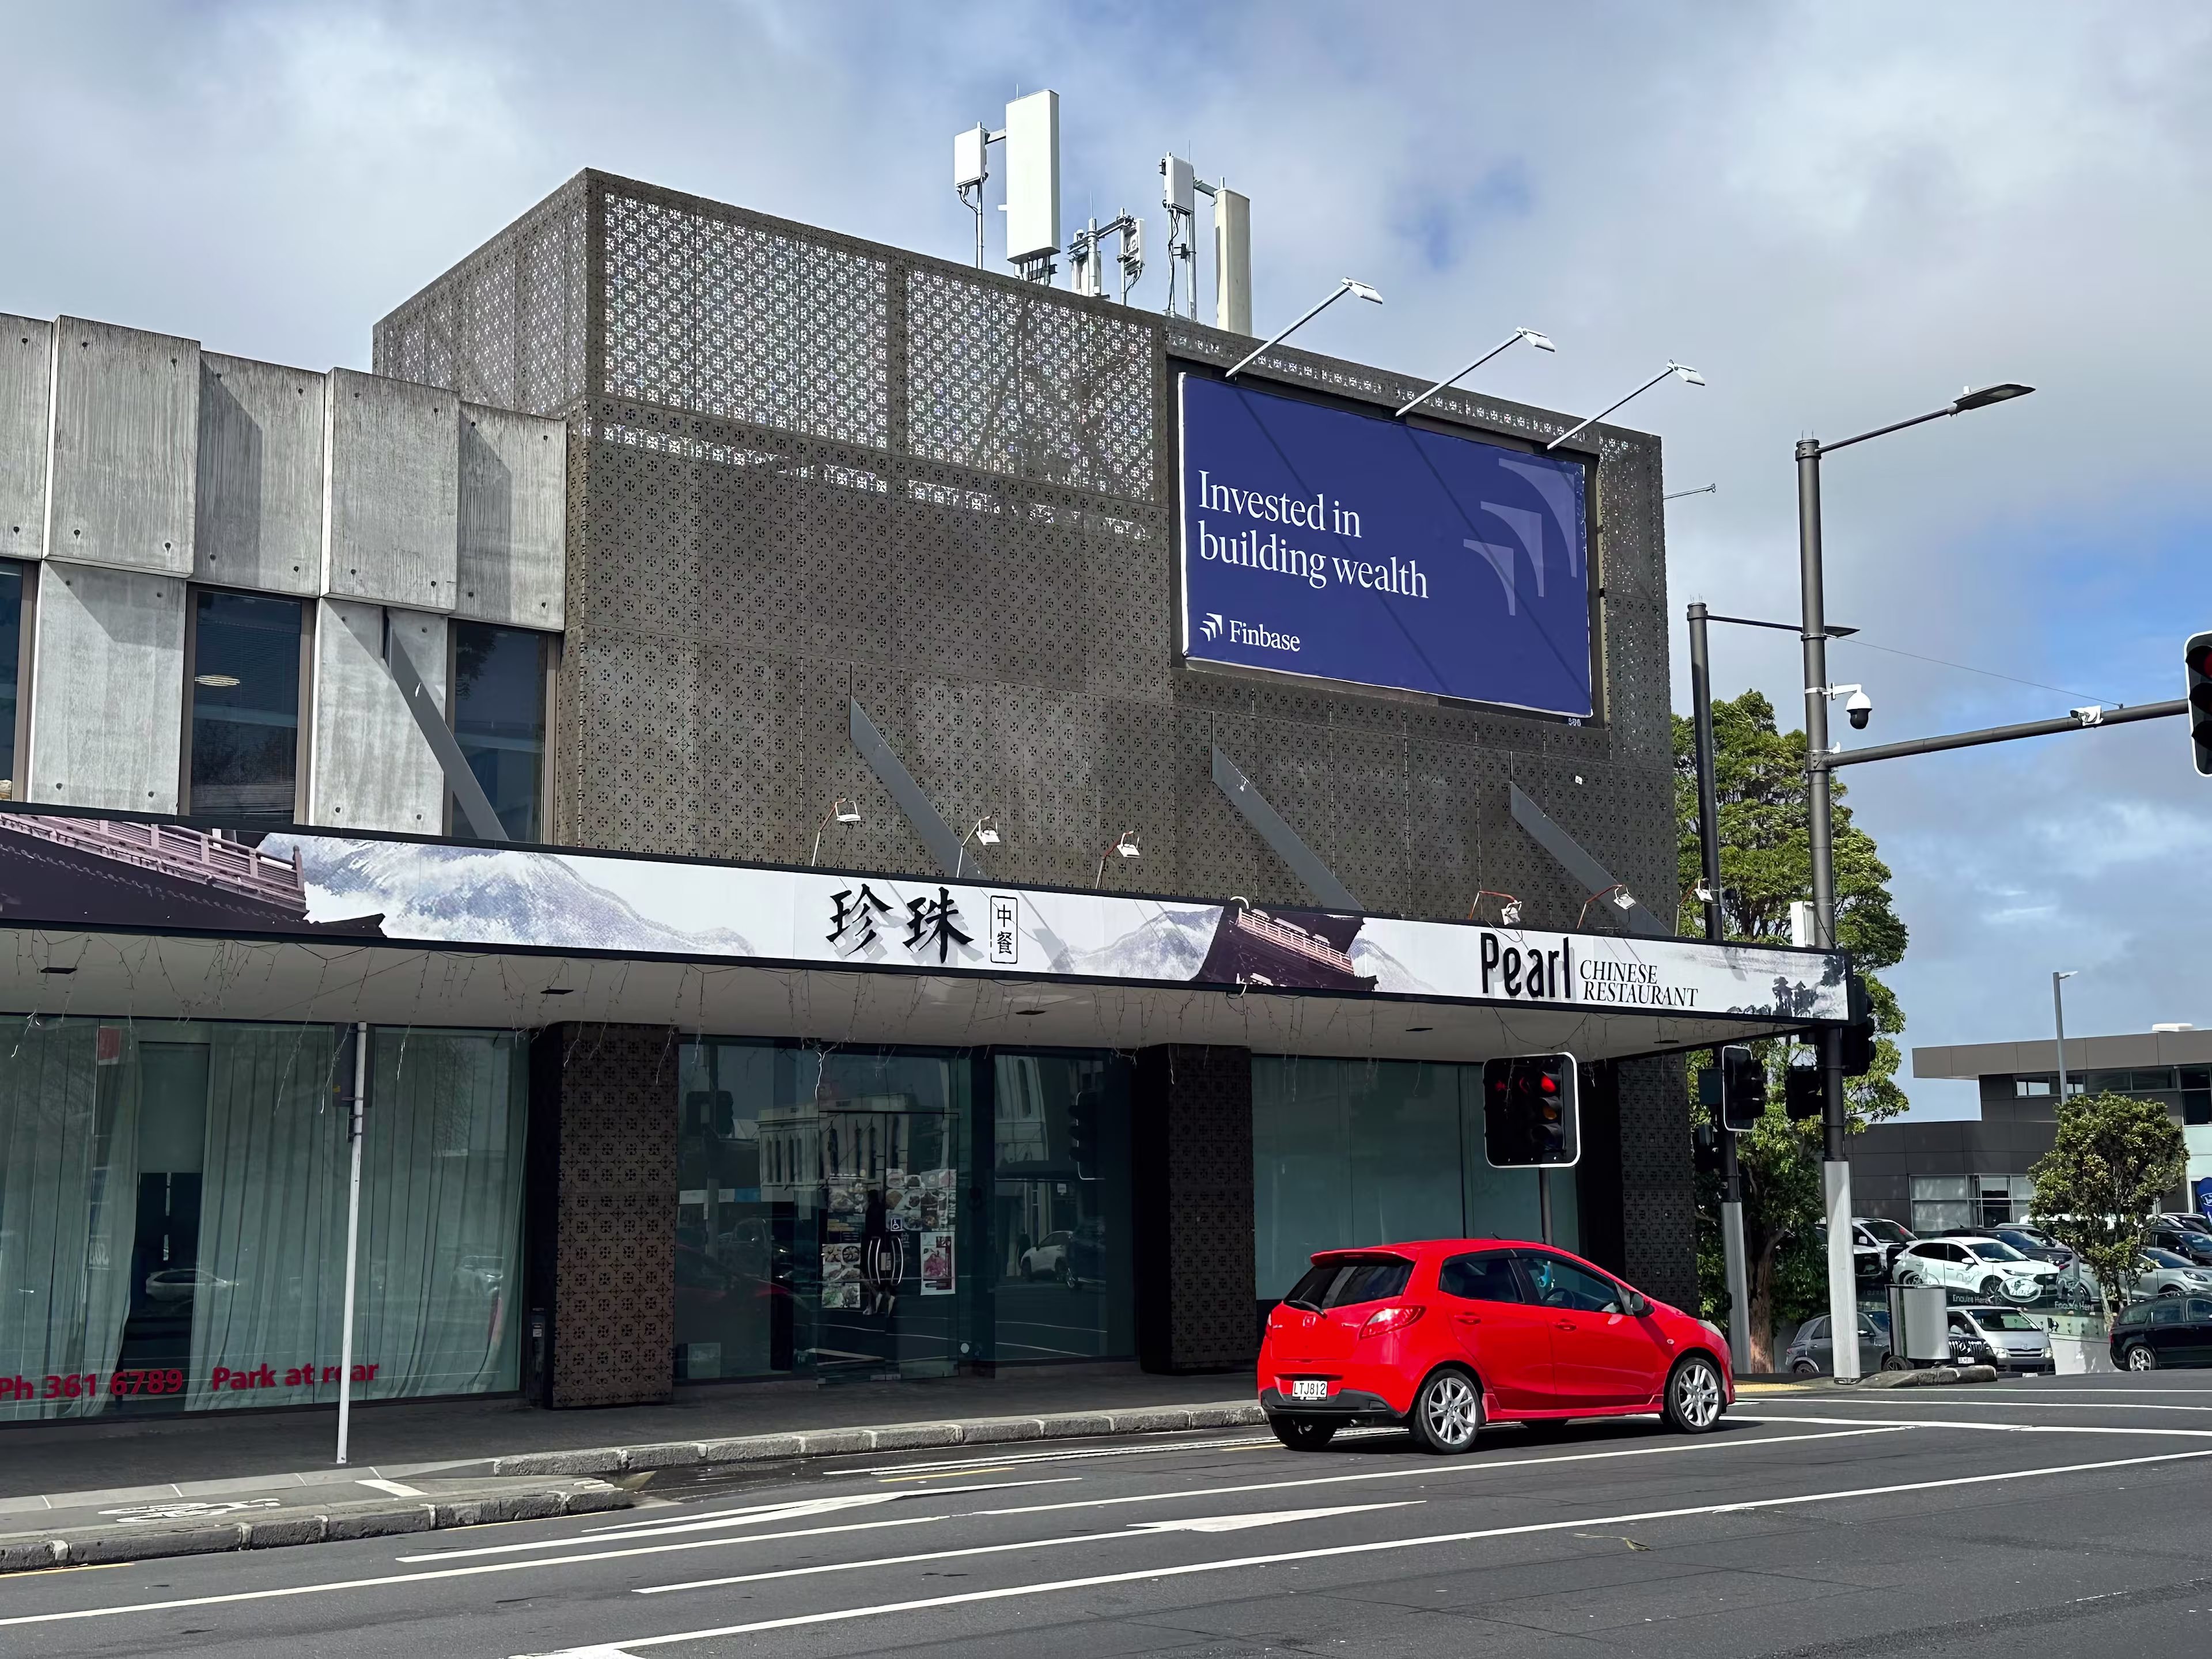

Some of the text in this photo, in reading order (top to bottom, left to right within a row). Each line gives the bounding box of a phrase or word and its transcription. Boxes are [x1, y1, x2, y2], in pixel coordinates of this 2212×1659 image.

[1198, 470, 1362, 539] Invested in
[1199, 520, 1429, 600] building wealth
[1229, 620, 1301, 652] Finbase
[826, 884, 974, 964] 珍珠
[997, 904, 1012, 955] 中餐
[1480, 932, 1571, 999] Pearl
[1580, 960, 1658, 984] CHINESE
[1584, 981, 1698, 1007] RESTAURANT
[0, 1374, 33, 1400] Ph
[43, 1373, 97, 1399] 361
[111, 1368, 183, 1395] 6789
[213, 1363, 277, 1391] Park
[284, 1363, 315, 1385] at
[1294, 1382, 1326, 1395] LTJ812
